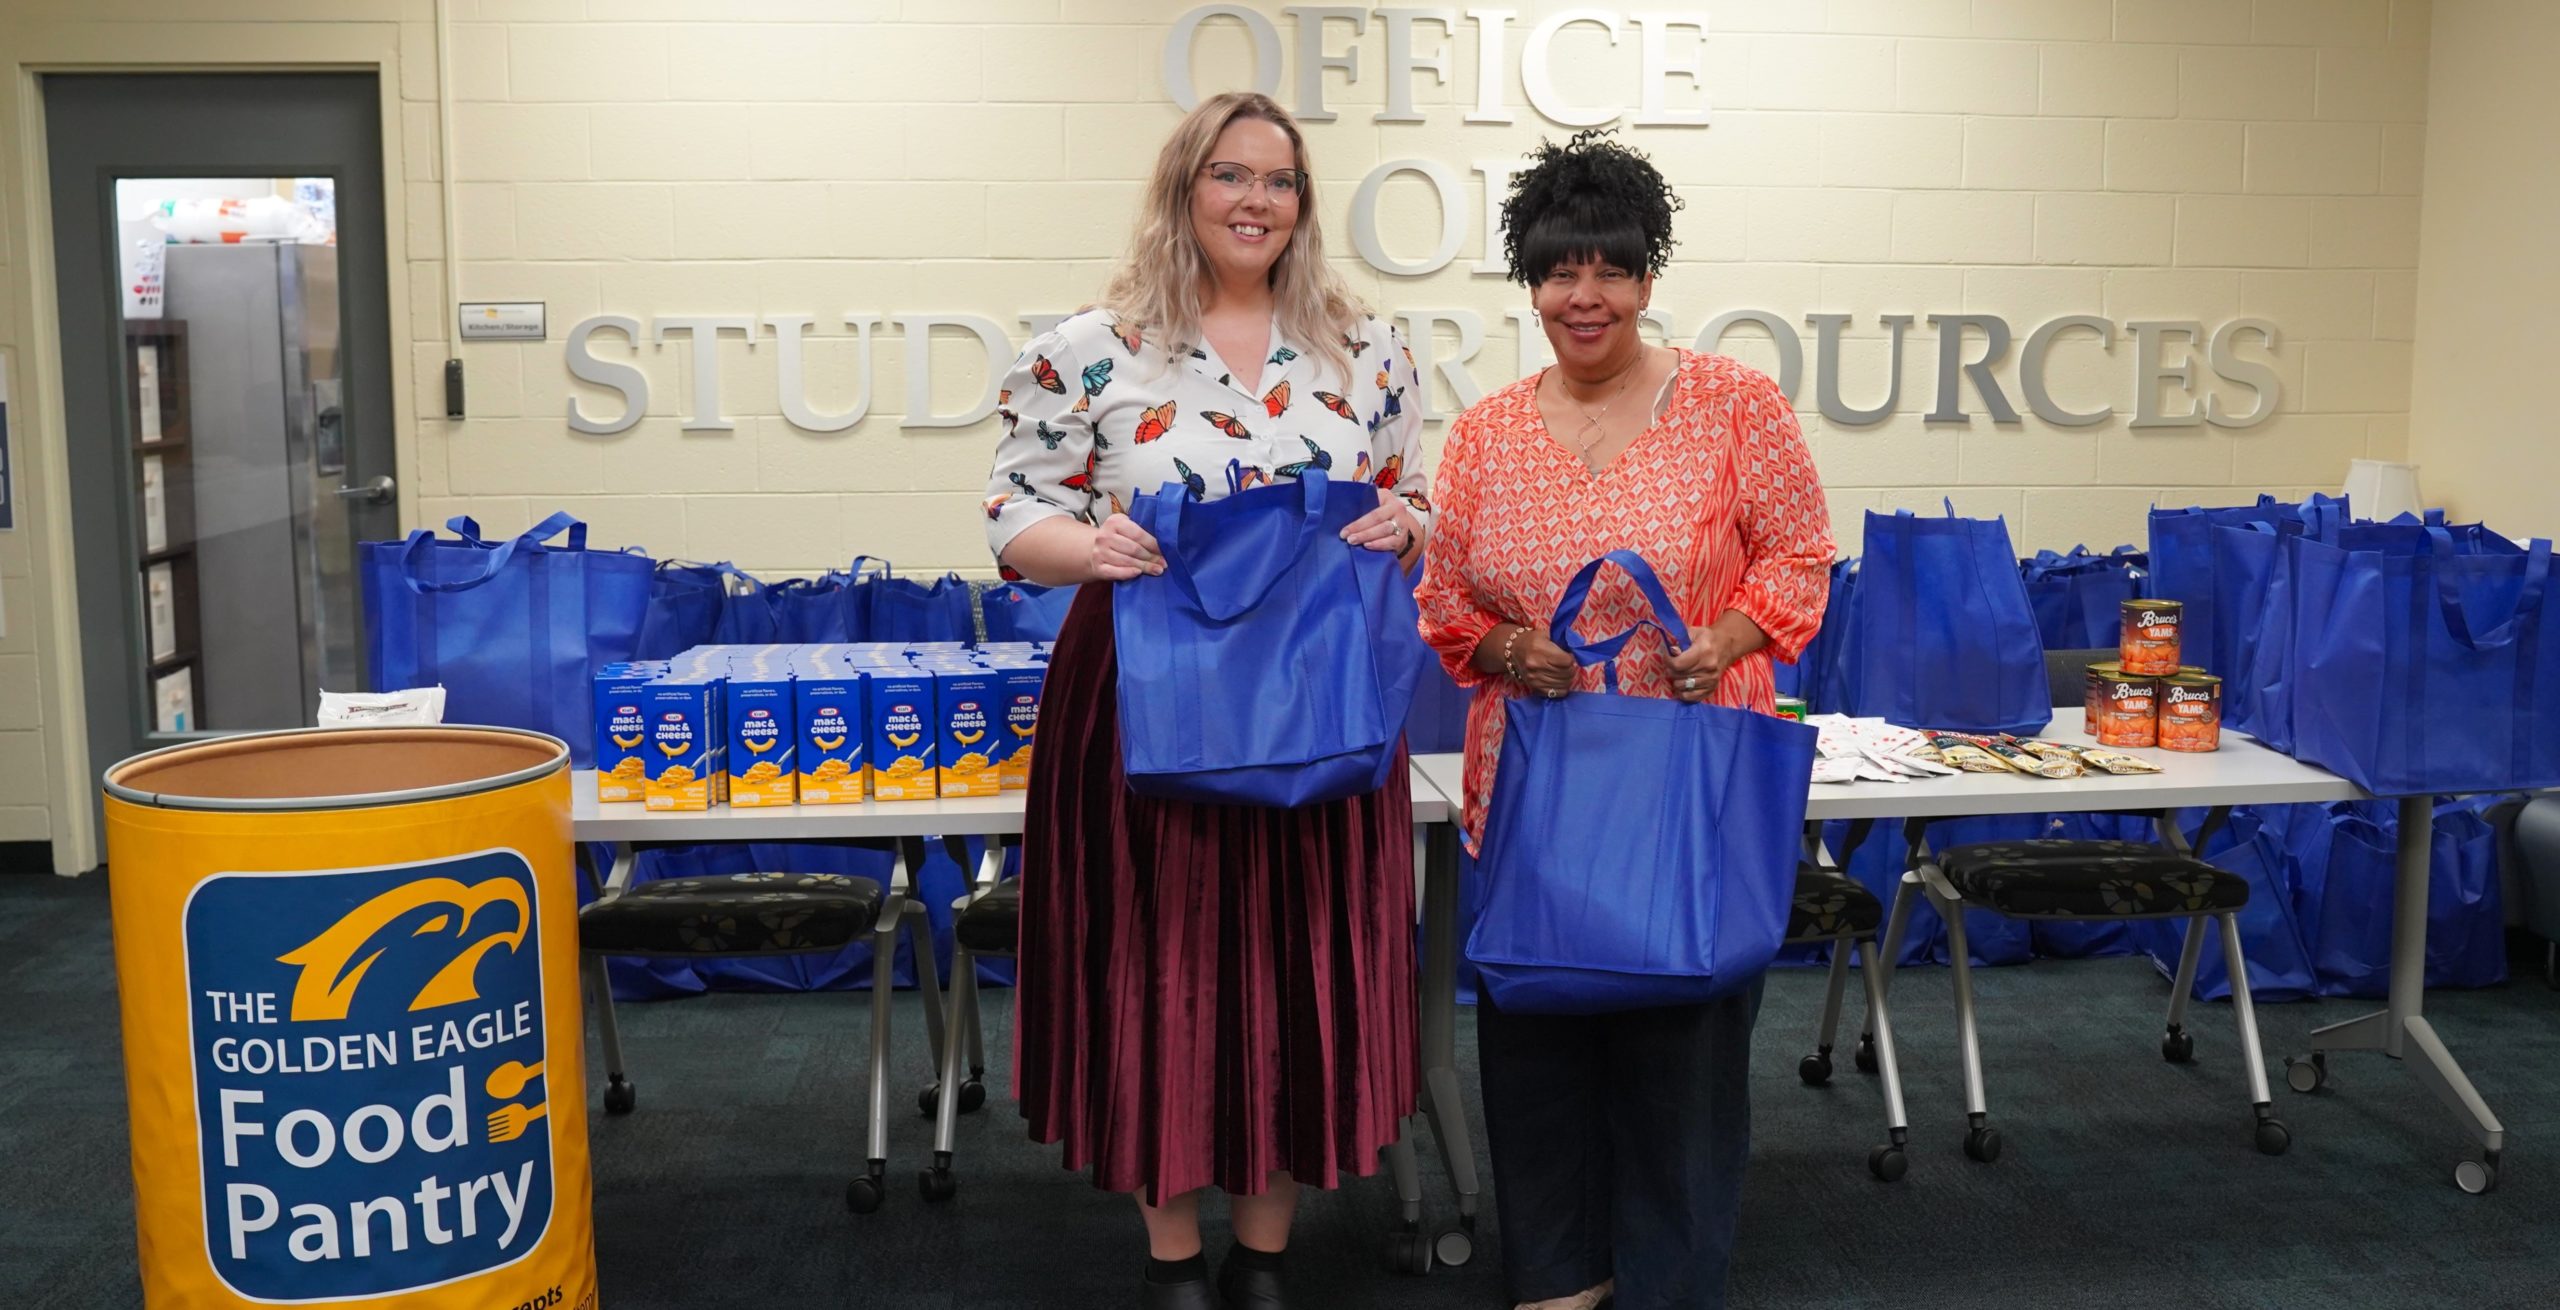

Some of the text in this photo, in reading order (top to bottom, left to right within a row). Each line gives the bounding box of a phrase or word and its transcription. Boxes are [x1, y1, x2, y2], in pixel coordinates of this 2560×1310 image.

[1163, 3, 1711, 127] OFFICE
[468, 323, 539, 332] Kitchen/Storage
[565, 314, 1072, 432] STUD
[2137, 610, 2177, 628] Bruce's
[2149, 627, 2173, 638] YAMS
[2111, 682, 2153, 700] Bruce's
[2167, 686, 2210, 703] Bruce's
[1011, 704, 1039, 713] mac &
[2122, 699, 2148, 710] YAMS
[2177, 703, 2204, 714] YAMS
[613, 715, 644, 724] mac &
[814, 716, 845, 726] mac &
[888, 713, 919, 723] mac &
[954, 711, 984, 720] mac &
[659, 722, 690, 732] mac &
[745, 718, 776, 728] mac &
[206, 990, 278, 1024] THE
[212, 1000, 531, 1075] GOLDEN EAGLE
[219, 1064, 469, 1169] Food
[226, 1159, 534, 1263] Pantry
